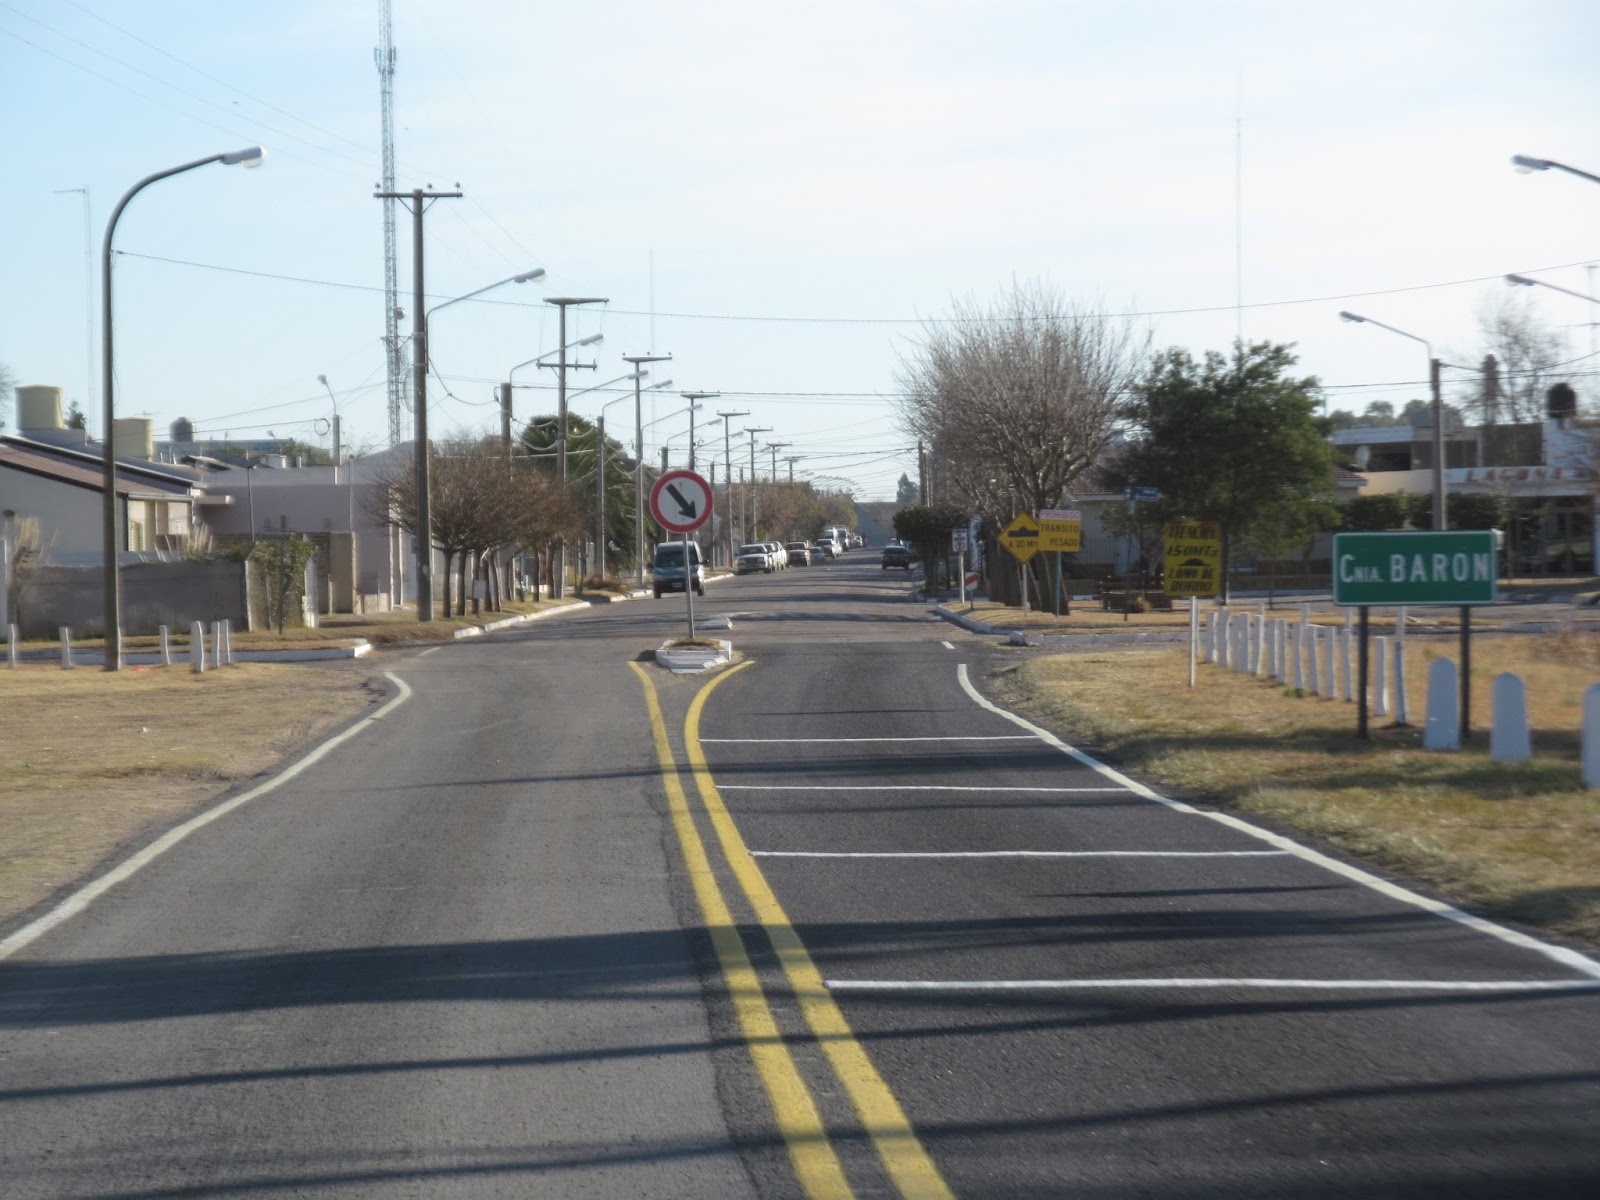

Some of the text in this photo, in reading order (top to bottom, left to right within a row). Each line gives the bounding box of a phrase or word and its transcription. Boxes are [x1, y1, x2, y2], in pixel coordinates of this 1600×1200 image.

[1041, 523, 1079, 533] TRANSITO
[1050, 537, 1078, 547] PESADO
[1390, 553, 1490, 582] BARON
